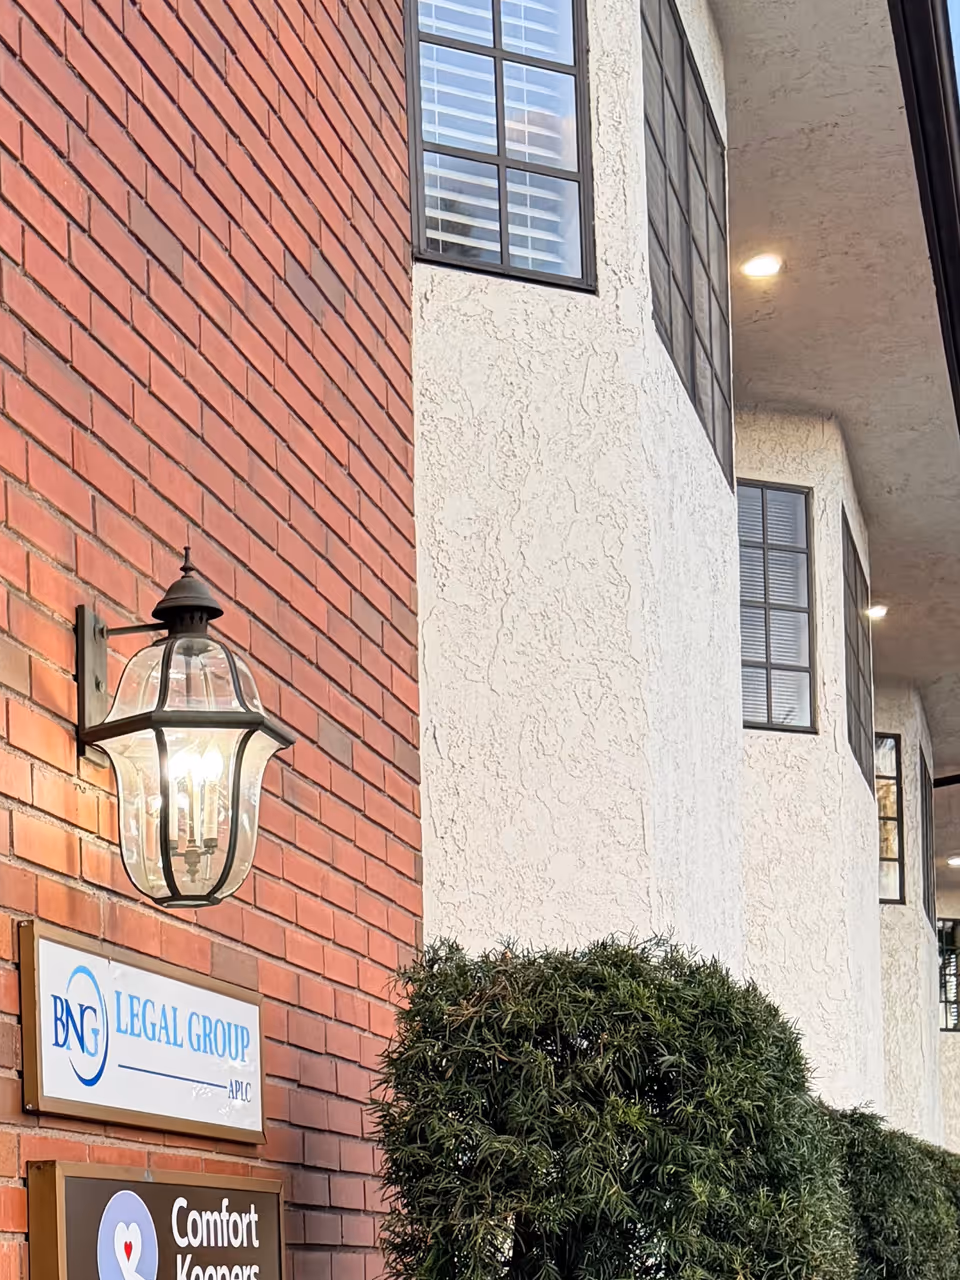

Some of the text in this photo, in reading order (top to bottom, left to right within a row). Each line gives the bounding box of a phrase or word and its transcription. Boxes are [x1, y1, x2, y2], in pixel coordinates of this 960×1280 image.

[50, 990, 250, 1063] BNG LEGAL GROUP
[228, 1079, 252, 1102] APLC
[171, 1196, 260, 1248] Comfort
